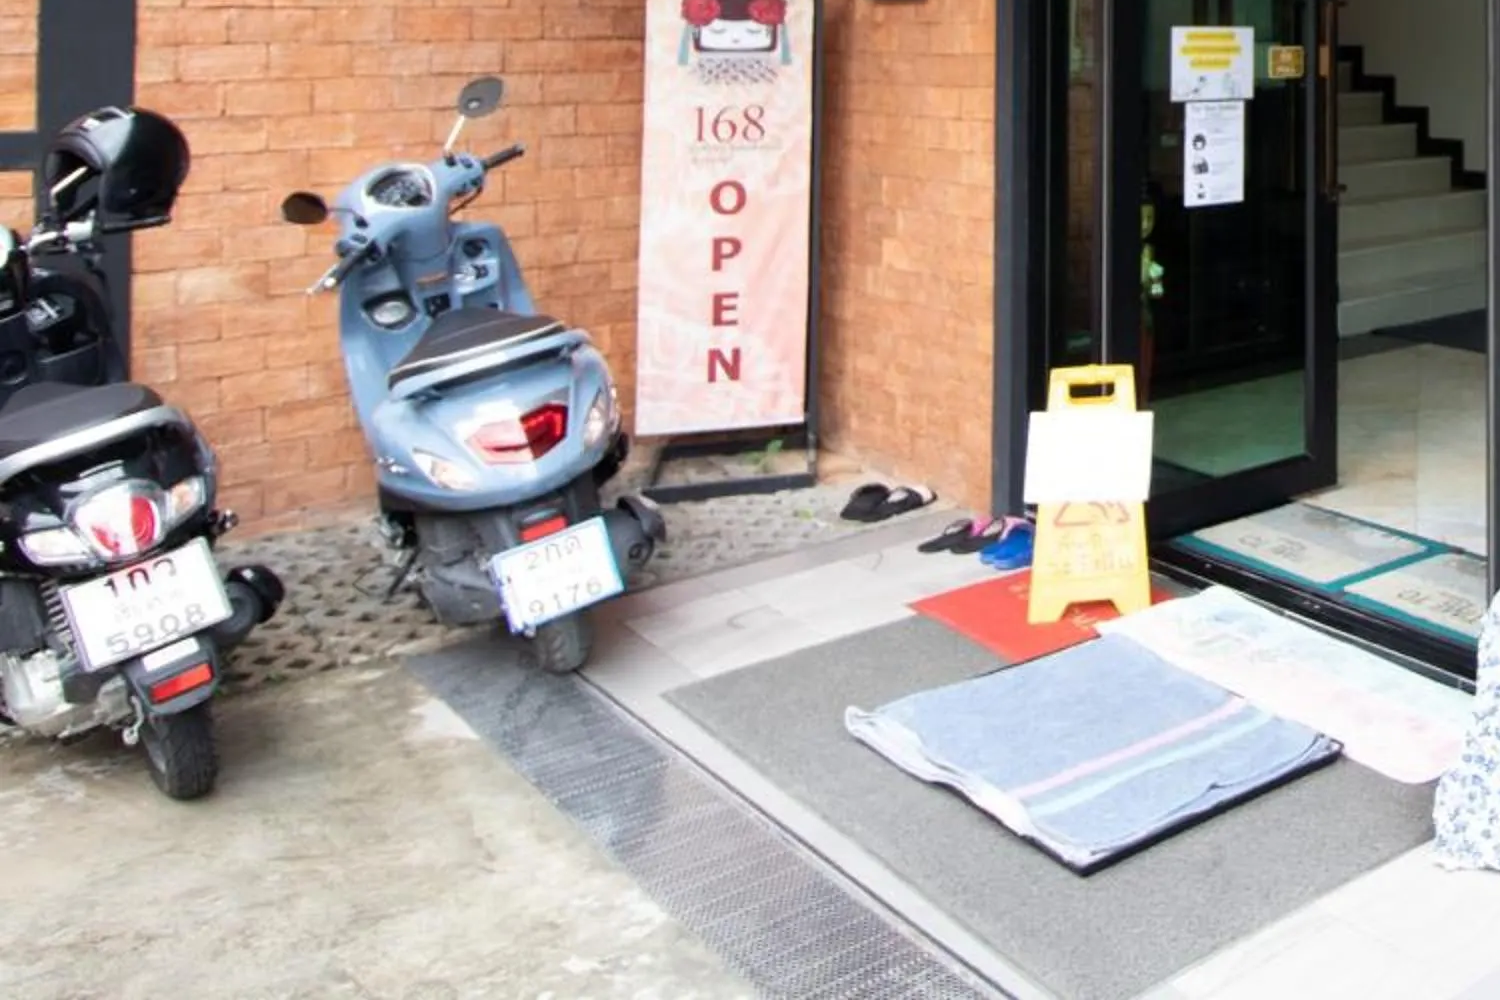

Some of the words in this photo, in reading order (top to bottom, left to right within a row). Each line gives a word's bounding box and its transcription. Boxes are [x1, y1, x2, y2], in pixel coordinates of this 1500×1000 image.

[693, 105, 767, 144] 168
[706, 179, 747, 383] OPEN
[104, 602, 207, 655] 5908
